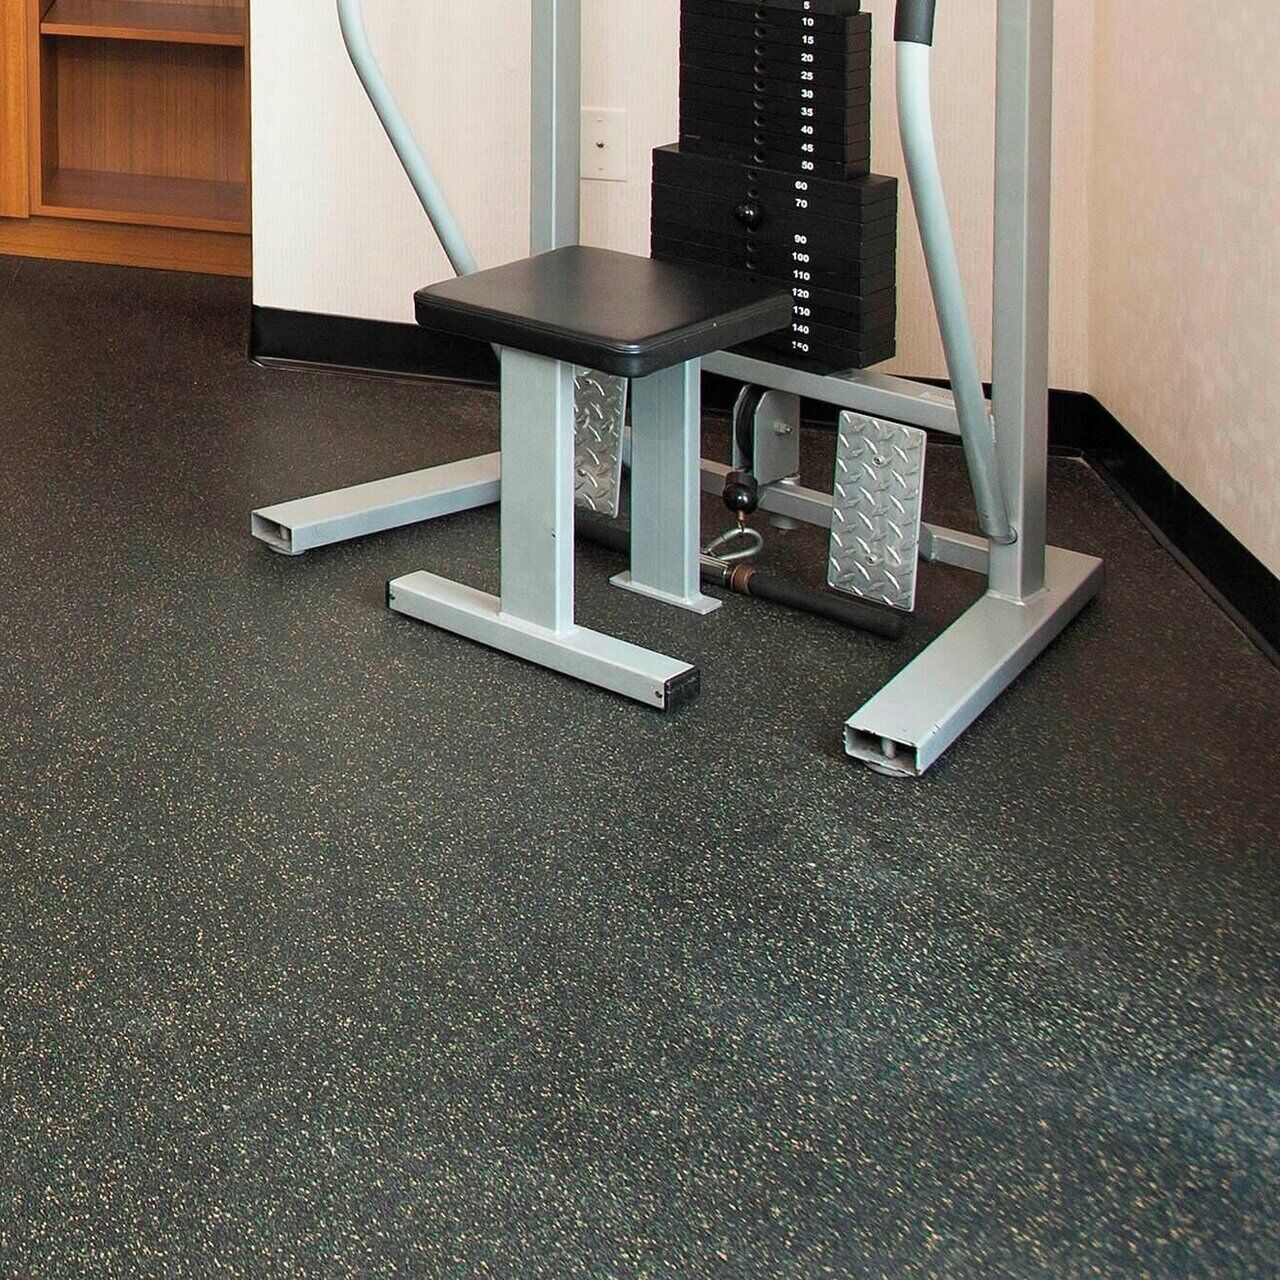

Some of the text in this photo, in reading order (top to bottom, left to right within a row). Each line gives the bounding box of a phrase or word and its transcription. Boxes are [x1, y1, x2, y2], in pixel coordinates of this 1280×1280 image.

[804, 1, 810, 9] 5
[802, 18, 814, 26] 10
[802, 35, 814, 44] 15
[801, 53, 813, 62] 20
[801, 71, 813, 80] 25
[802, 89, 813, 98] 30
[801, 107, 813, 116] 35
[801, 126, 813, 134] 40
[802, 144, 813, 152] 45
[802, 161, 813, 170] 50
[795, 181, 807, 190] 60
[796, 199, 807, 208] 70
[795, 235, 807, 244] 90
[793, 252, 809, 262] 100
[794, 270, 810, 280] 110
[792, 288, 809, 298] 120
[793, 306, 810, 316] 130
[792, 324, 809, 334] 140
